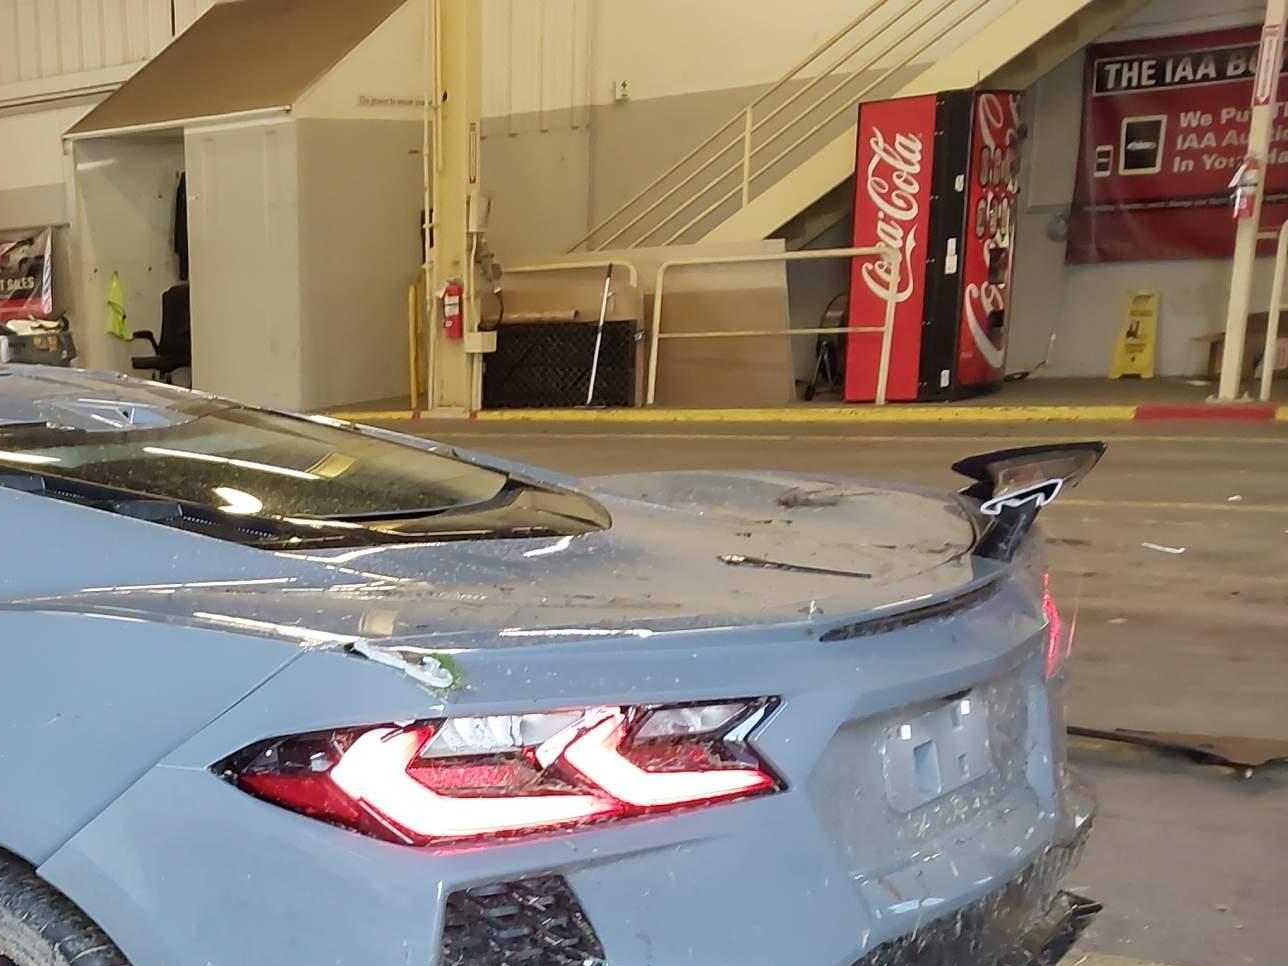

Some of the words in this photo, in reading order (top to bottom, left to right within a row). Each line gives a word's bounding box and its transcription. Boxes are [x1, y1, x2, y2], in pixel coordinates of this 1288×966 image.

[1104, 59, 1157, 89] THE
[1165, 53, 1217, 83] IAA
[1179, 110, 1212, 129] We
[1220, 107, 1252, 125] Pu
[1176, 131, 1217, 151] IAA
[1173, 156, 1194, 173] In
